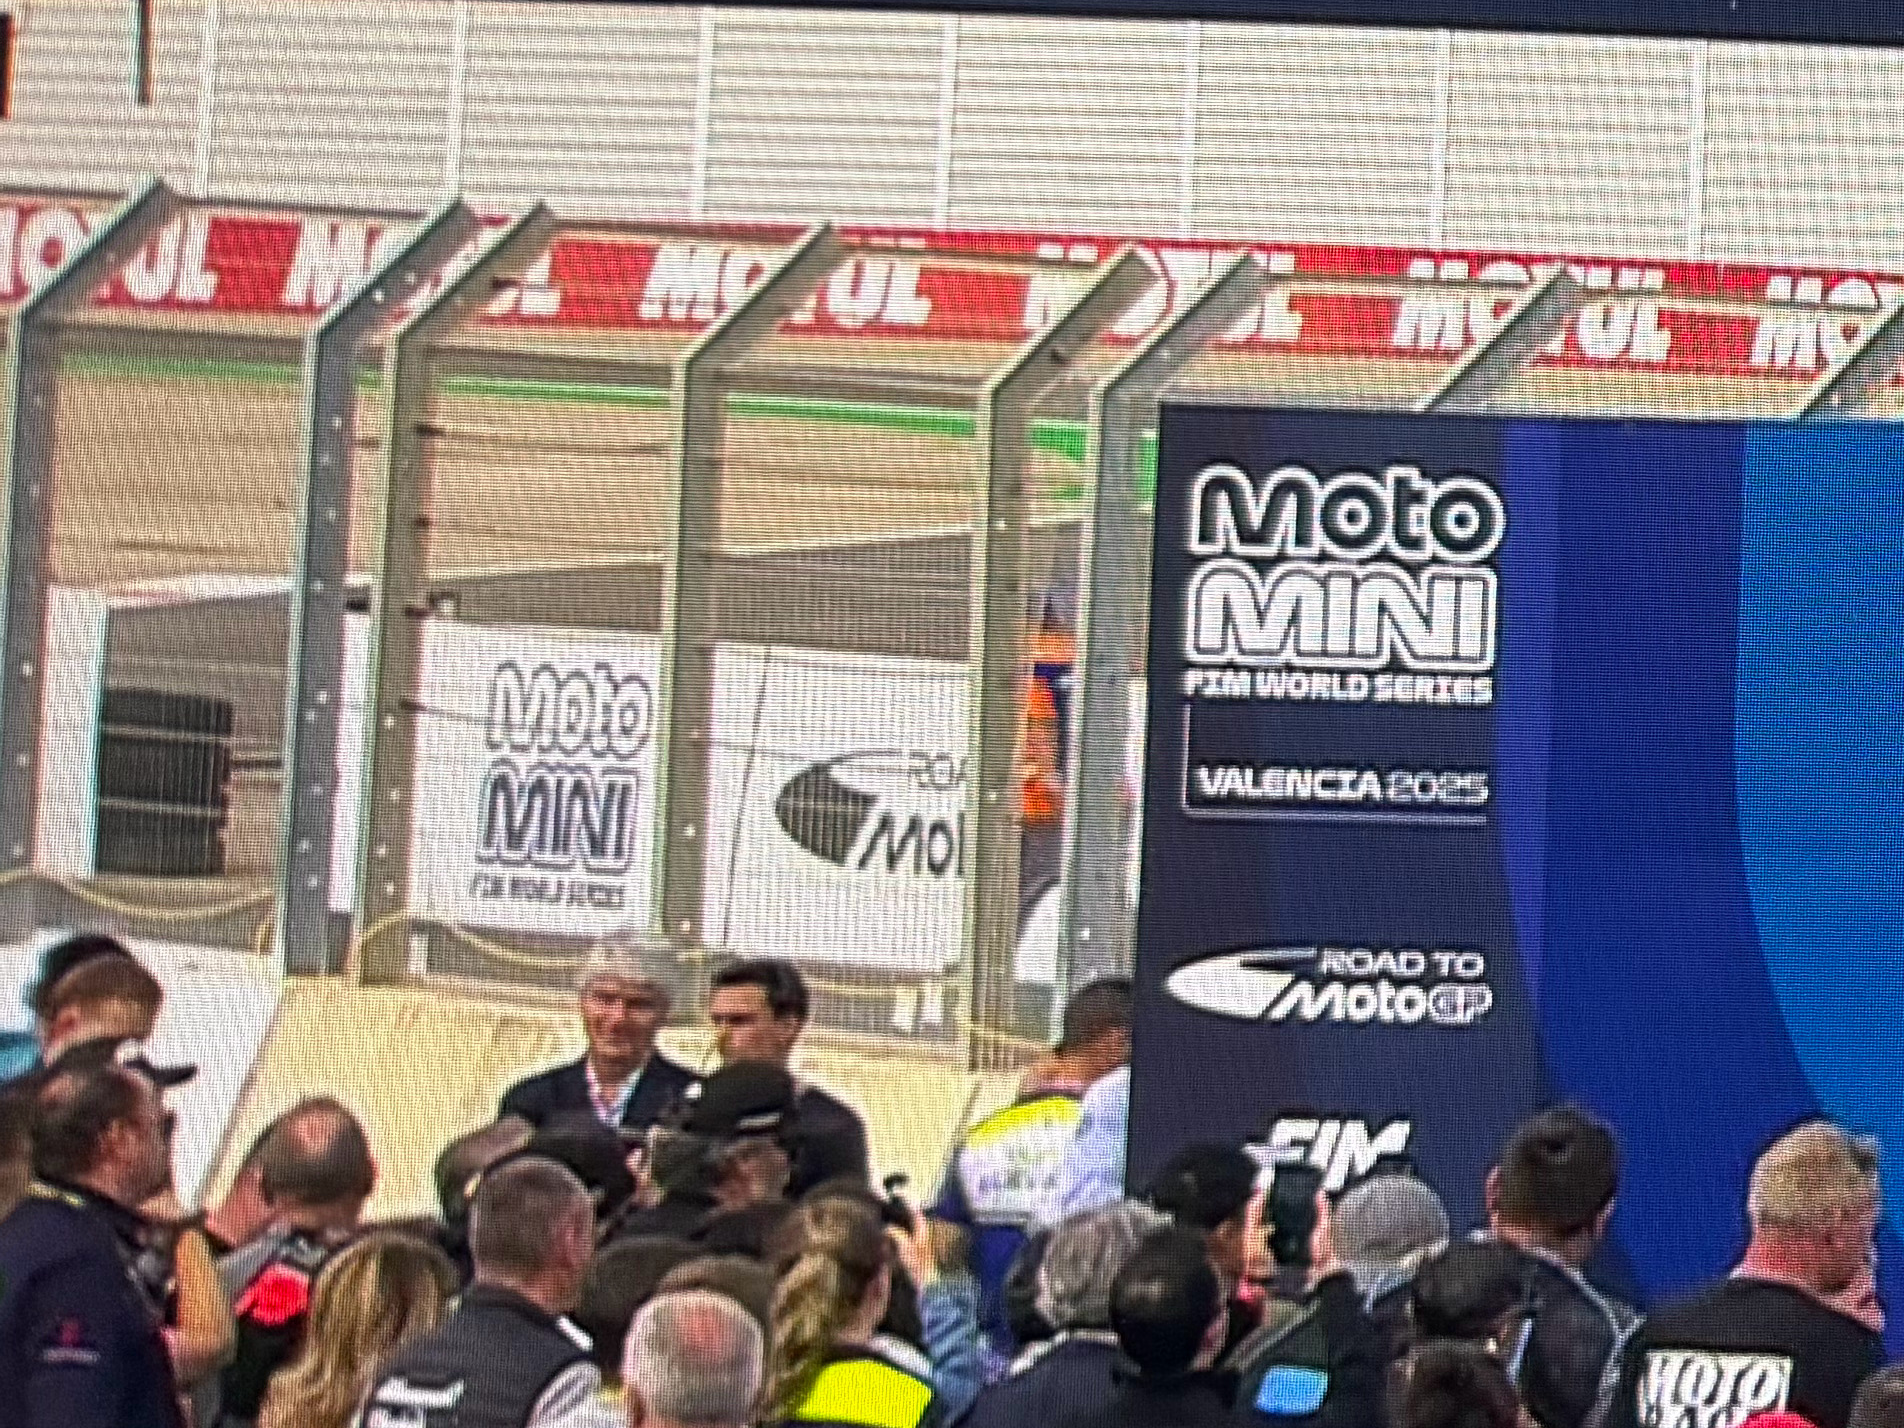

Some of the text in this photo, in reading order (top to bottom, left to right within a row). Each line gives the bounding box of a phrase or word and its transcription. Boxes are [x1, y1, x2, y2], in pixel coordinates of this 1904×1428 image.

[1185, 558, 1499, 671] MINI
[1183, 668, 1493, 705] FIM WORLD SERIES
[1195, 765, 1490, 805] VALENCIA 2025
[1320, 948, 1485, 979] ROAD TO
